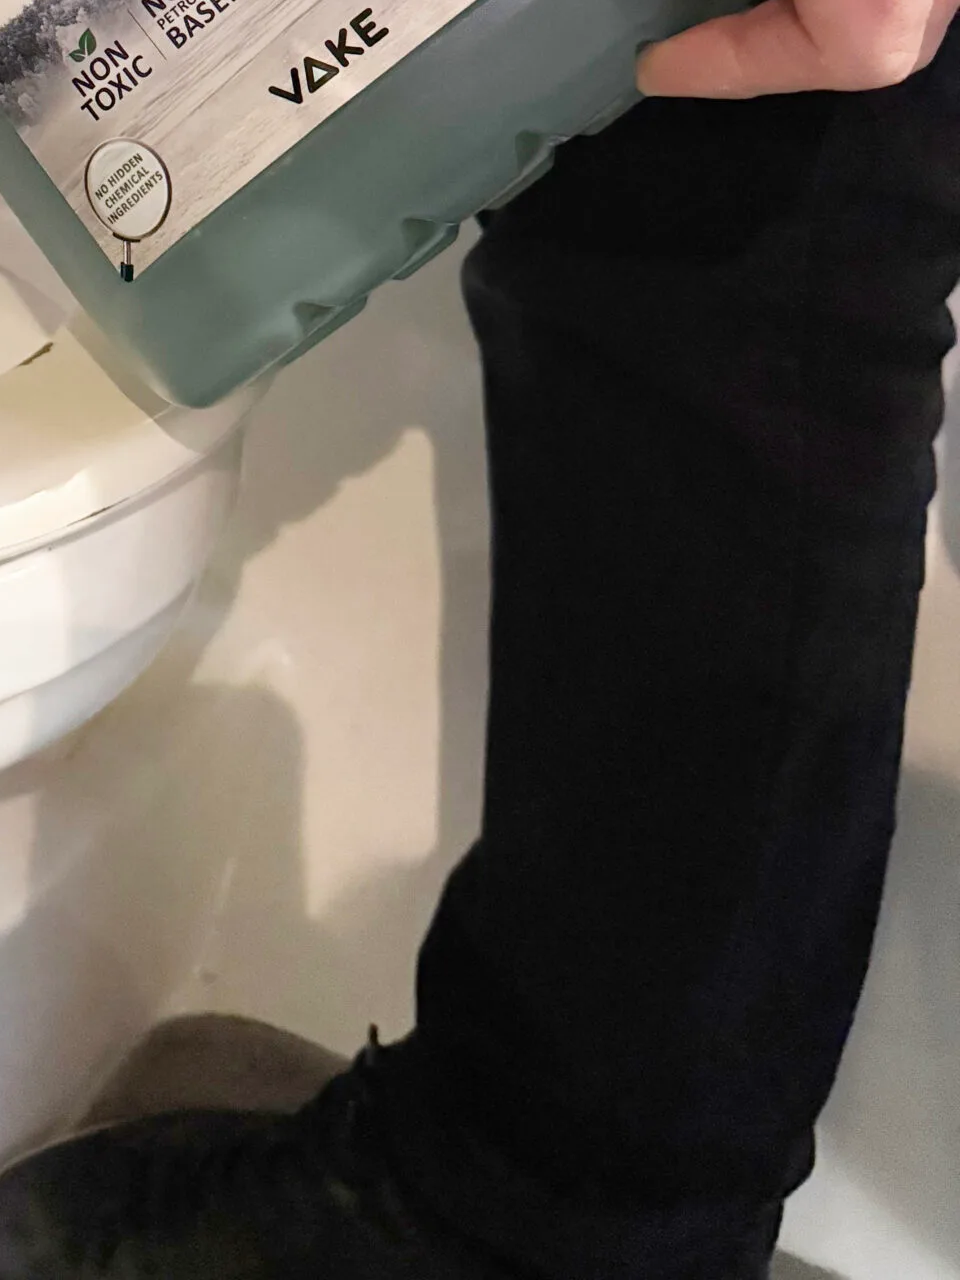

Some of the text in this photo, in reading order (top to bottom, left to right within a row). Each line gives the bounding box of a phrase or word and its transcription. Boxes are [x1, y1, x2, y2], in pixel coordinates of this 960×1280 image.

[71, 39, 130, 98] NON
[268, 7, 390, 105] VAKE
[80, 55, 153, 121] TOXIC
[94, 153, 144, 200] NO HIDDEN
[104, 166, 150, 209] CHEMICAL
[107, 170, 164, 224] INGREDIENTS
